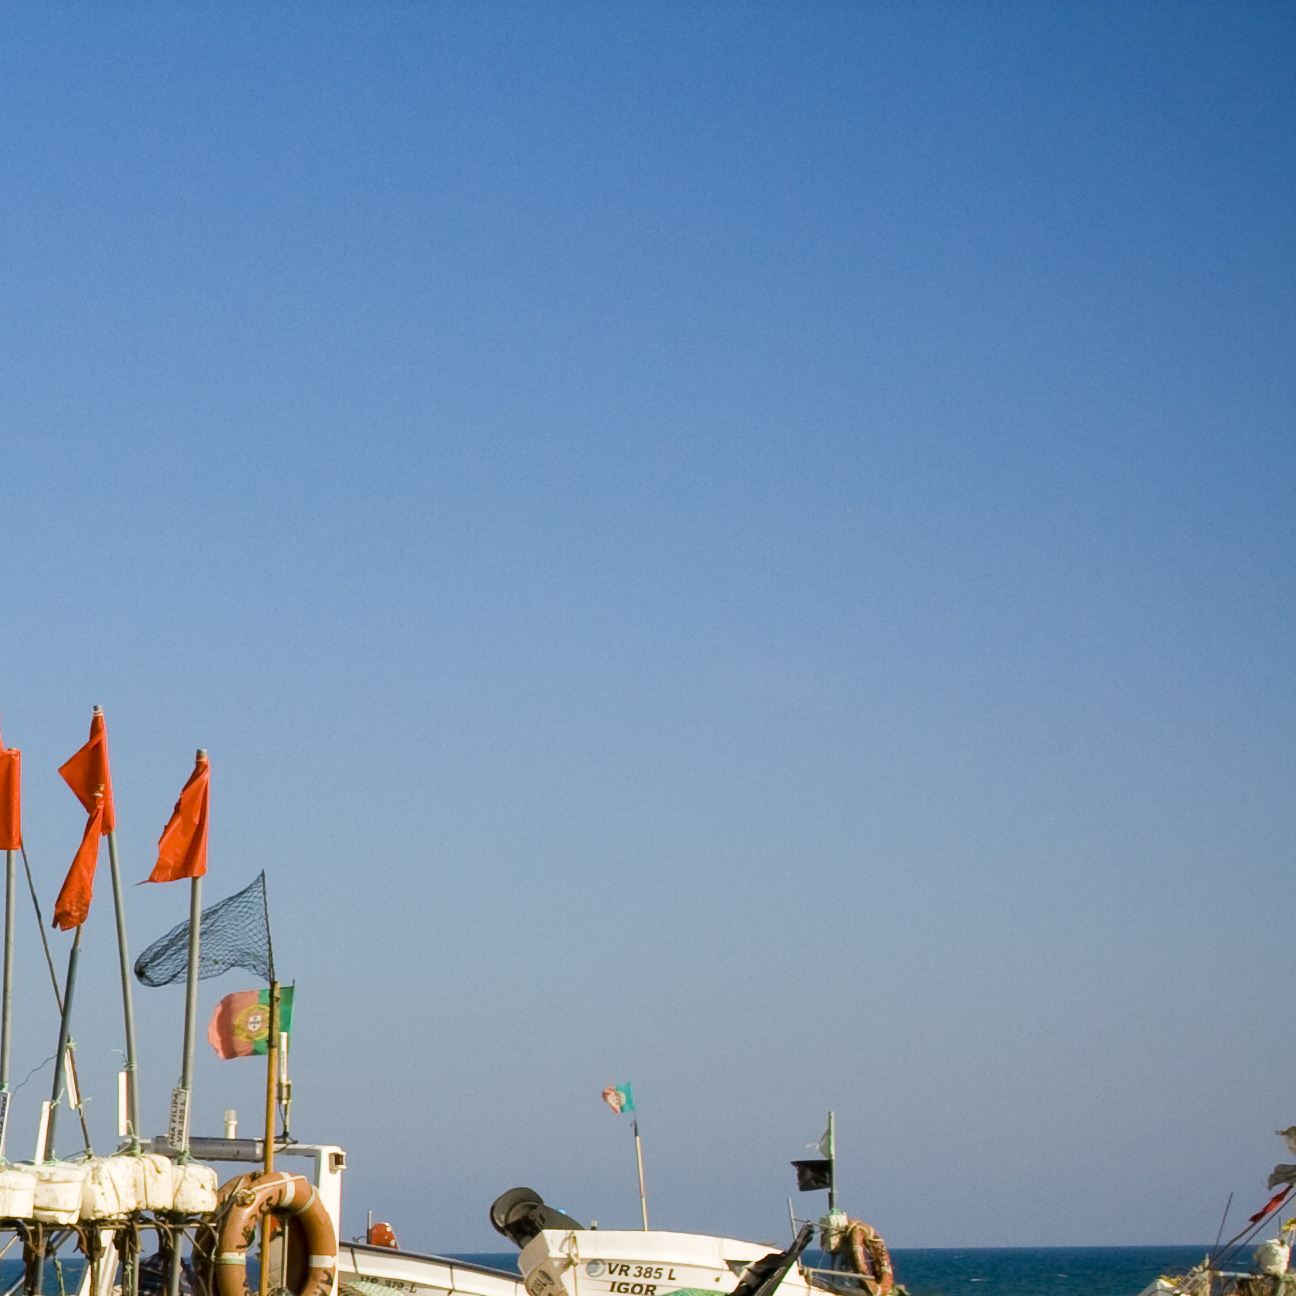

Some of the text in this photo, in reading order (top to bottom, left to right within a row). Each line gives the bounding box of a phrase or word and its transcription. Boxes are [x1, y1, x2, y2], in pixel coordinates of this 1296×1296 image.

[607, 1262, 677, 1281] VR 385 L
[609, 1281, 657, 1296] IGOR
